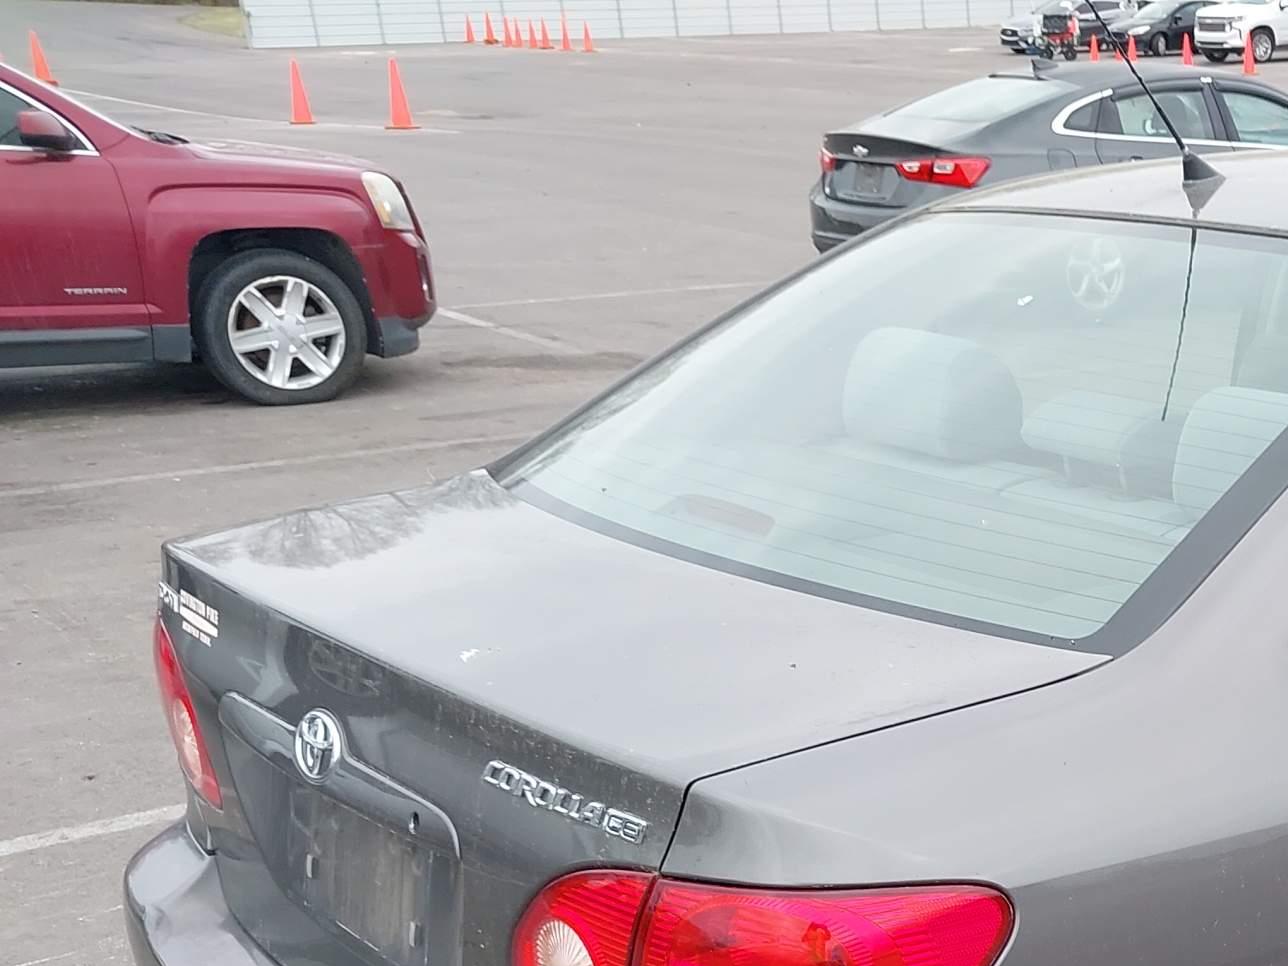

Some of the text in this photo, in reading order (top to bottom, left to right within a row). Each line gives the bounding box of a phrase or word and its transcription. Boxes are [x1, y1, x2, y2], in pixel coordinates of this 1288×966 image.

[63, 287, 127, 296] TERRAIN
[481, 760, 649, 845] COROLLA CE
